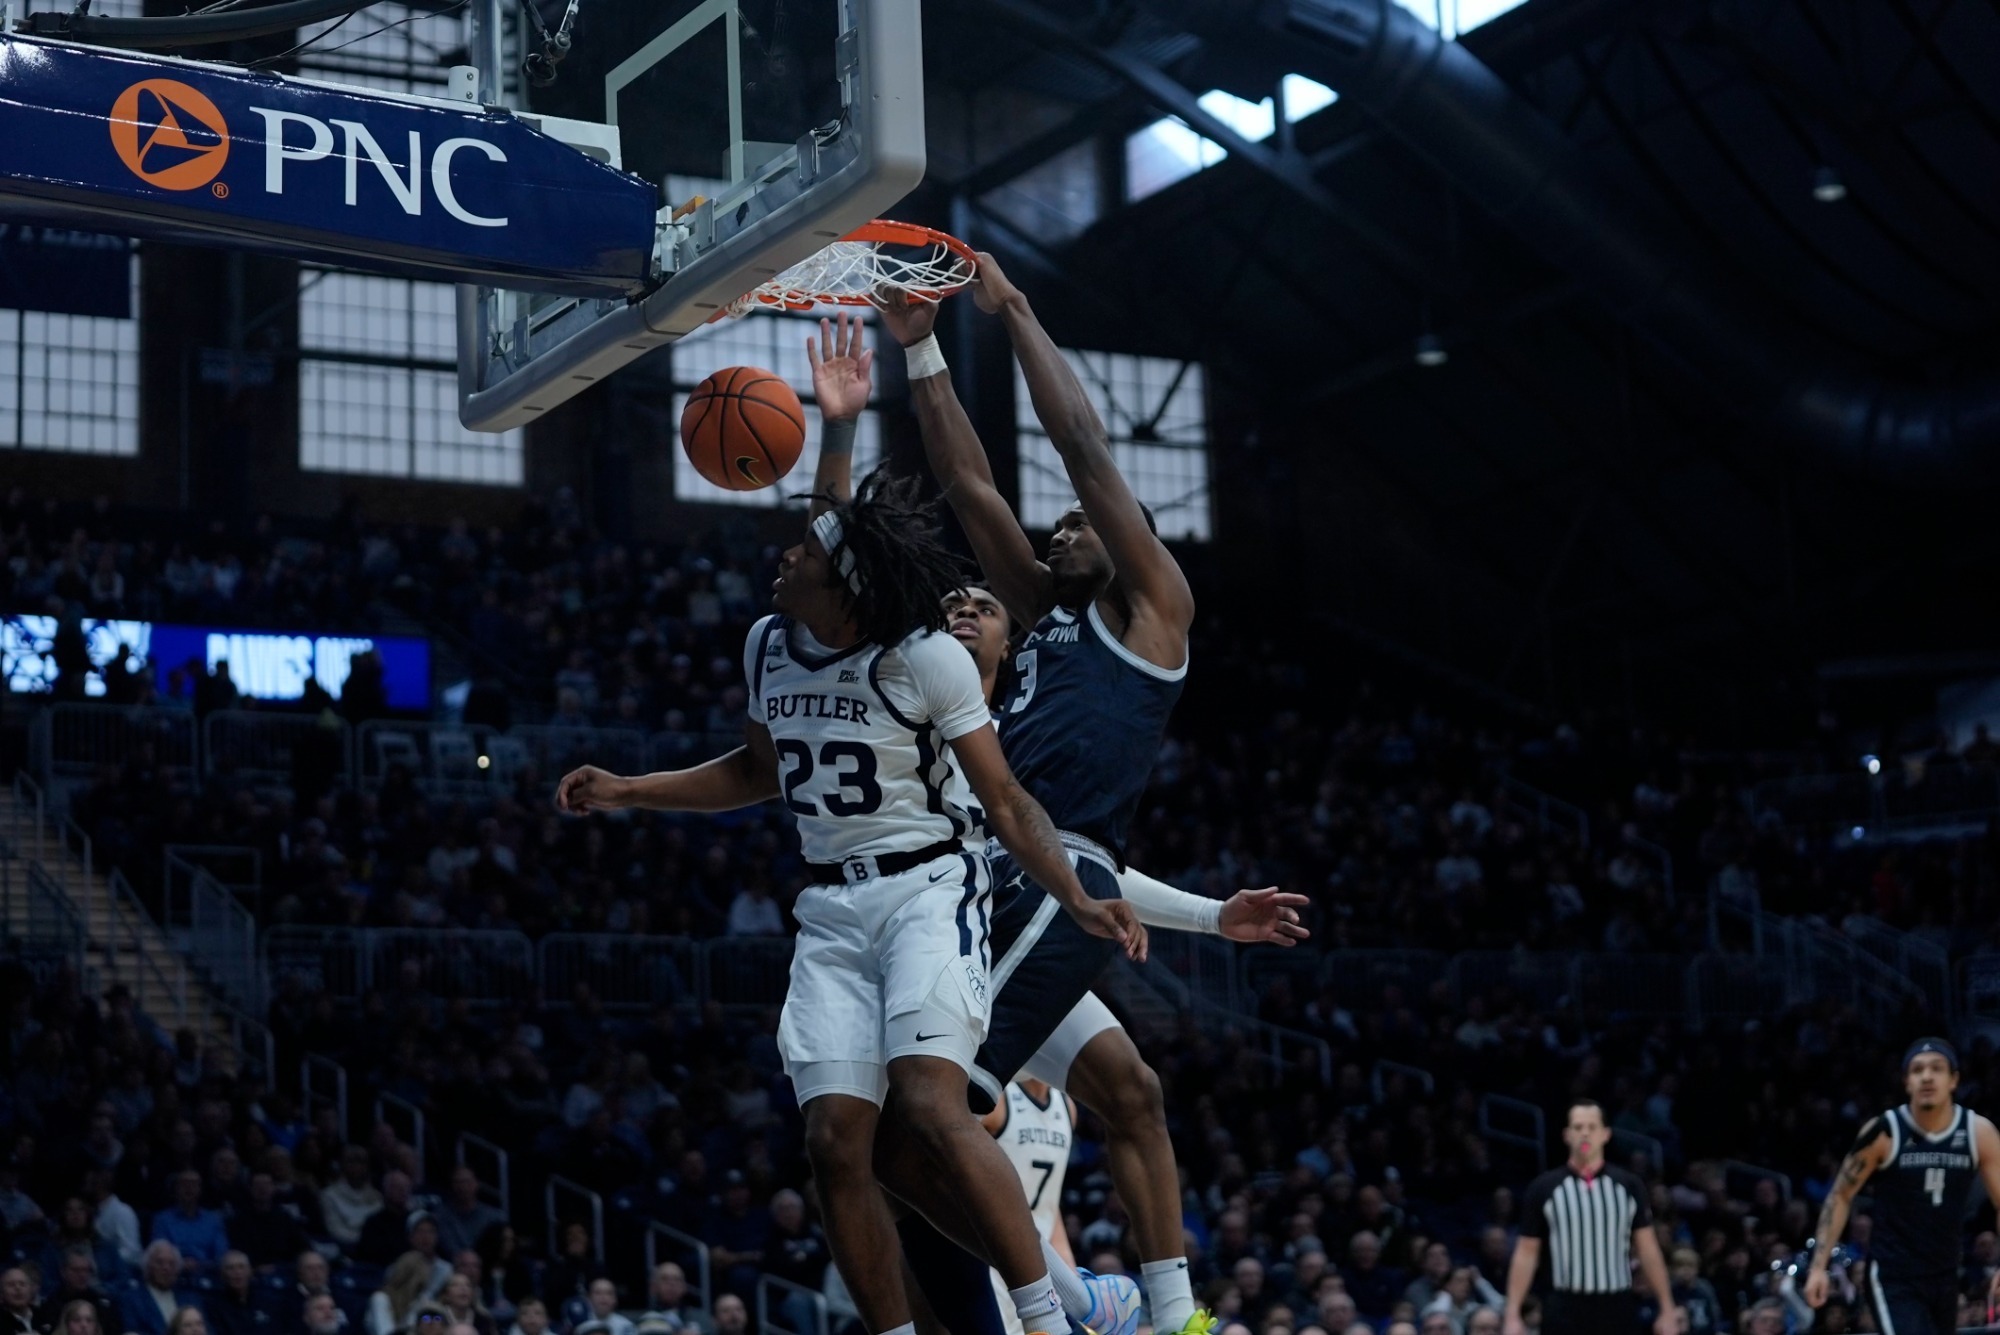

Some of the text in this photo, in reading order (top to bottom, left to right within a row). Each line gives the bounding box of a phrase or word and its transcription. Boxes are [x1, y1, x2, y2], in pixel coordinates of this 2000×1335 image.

[249, 106, 509, 227] PNC
[1010, 648, 1038, 713] 3
[766, 693, 871, 727] BUTLER
[775, 738, 883, 817] 23
[851, 862, 868, 881] B
[1018, 1127, 1068, 1149] BUTLER
[1899, 1151, 1972, 1169] GEORGETOWN
[1031, 1160, 1055, 1211] 7
[1923, 1167, 1947, 1207] 4
